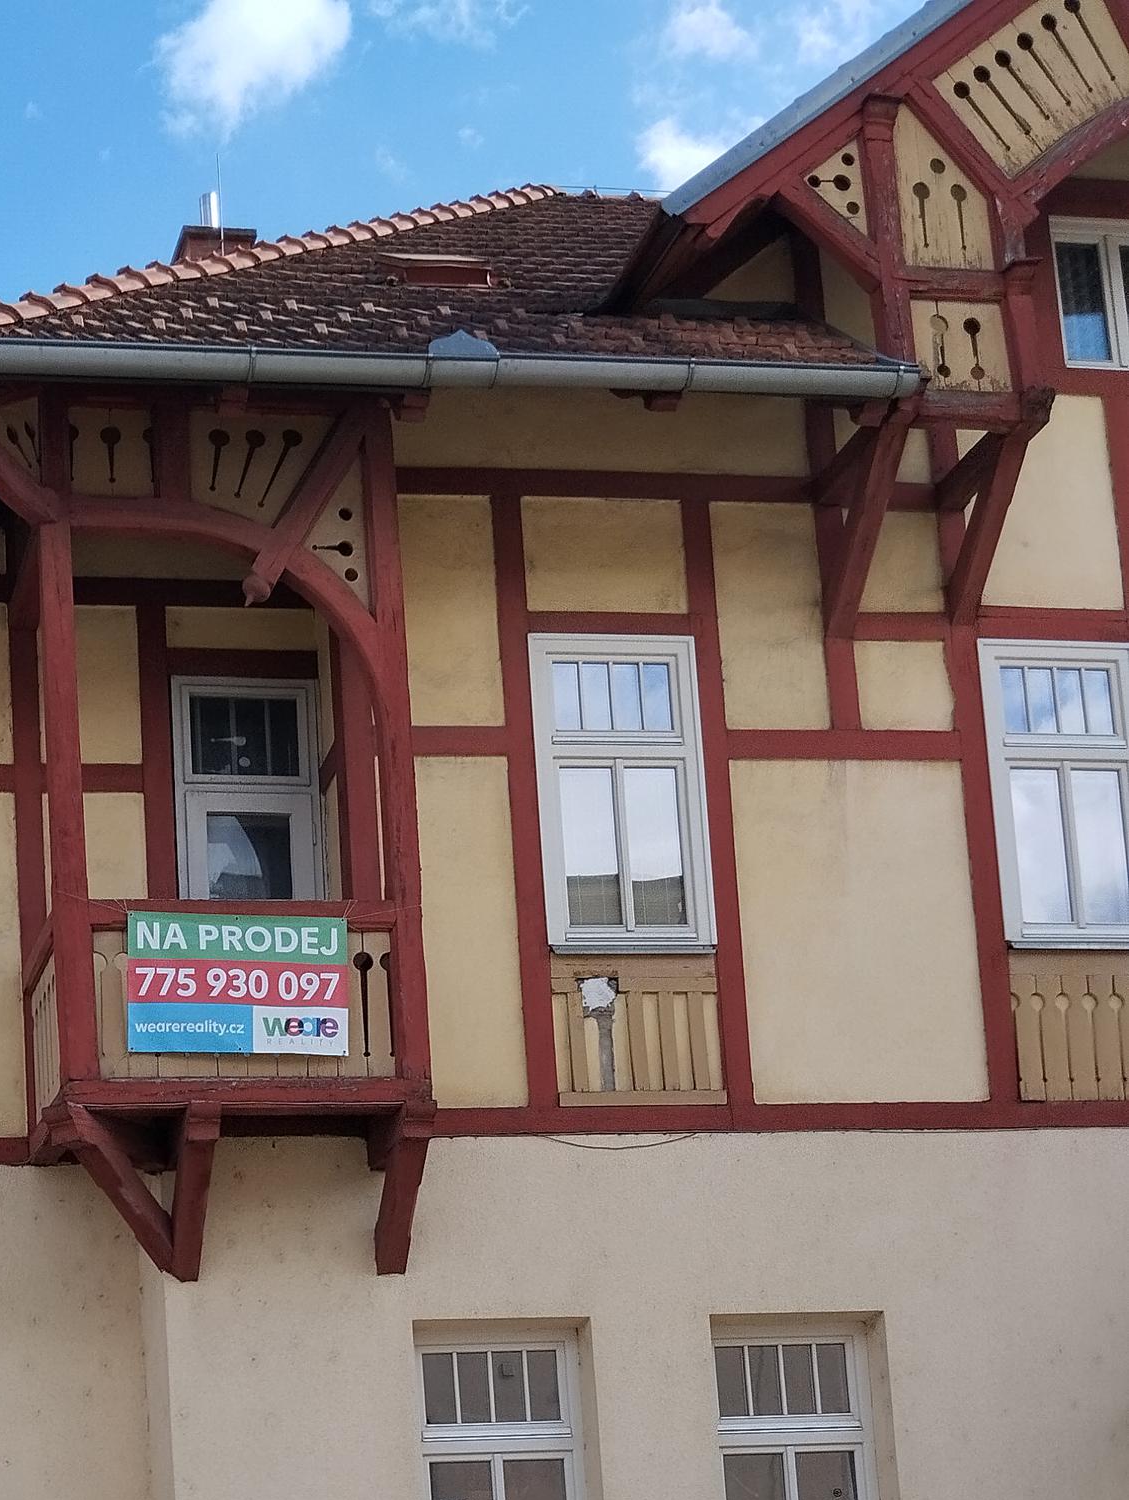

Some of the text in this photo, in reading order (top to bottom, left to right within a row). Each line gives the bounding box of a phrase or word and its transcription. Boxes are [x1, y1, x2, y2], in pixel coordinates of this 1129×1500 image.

[136, 921, 338, 956] NA PRODEJ
[135, 967, 340, 1001] 775 930 097
[135, 1019, 245, 1036] wearereality.cz
[262, 1016, 339, 1038] weare
[266, 1038, 334, 1047] REALITY
